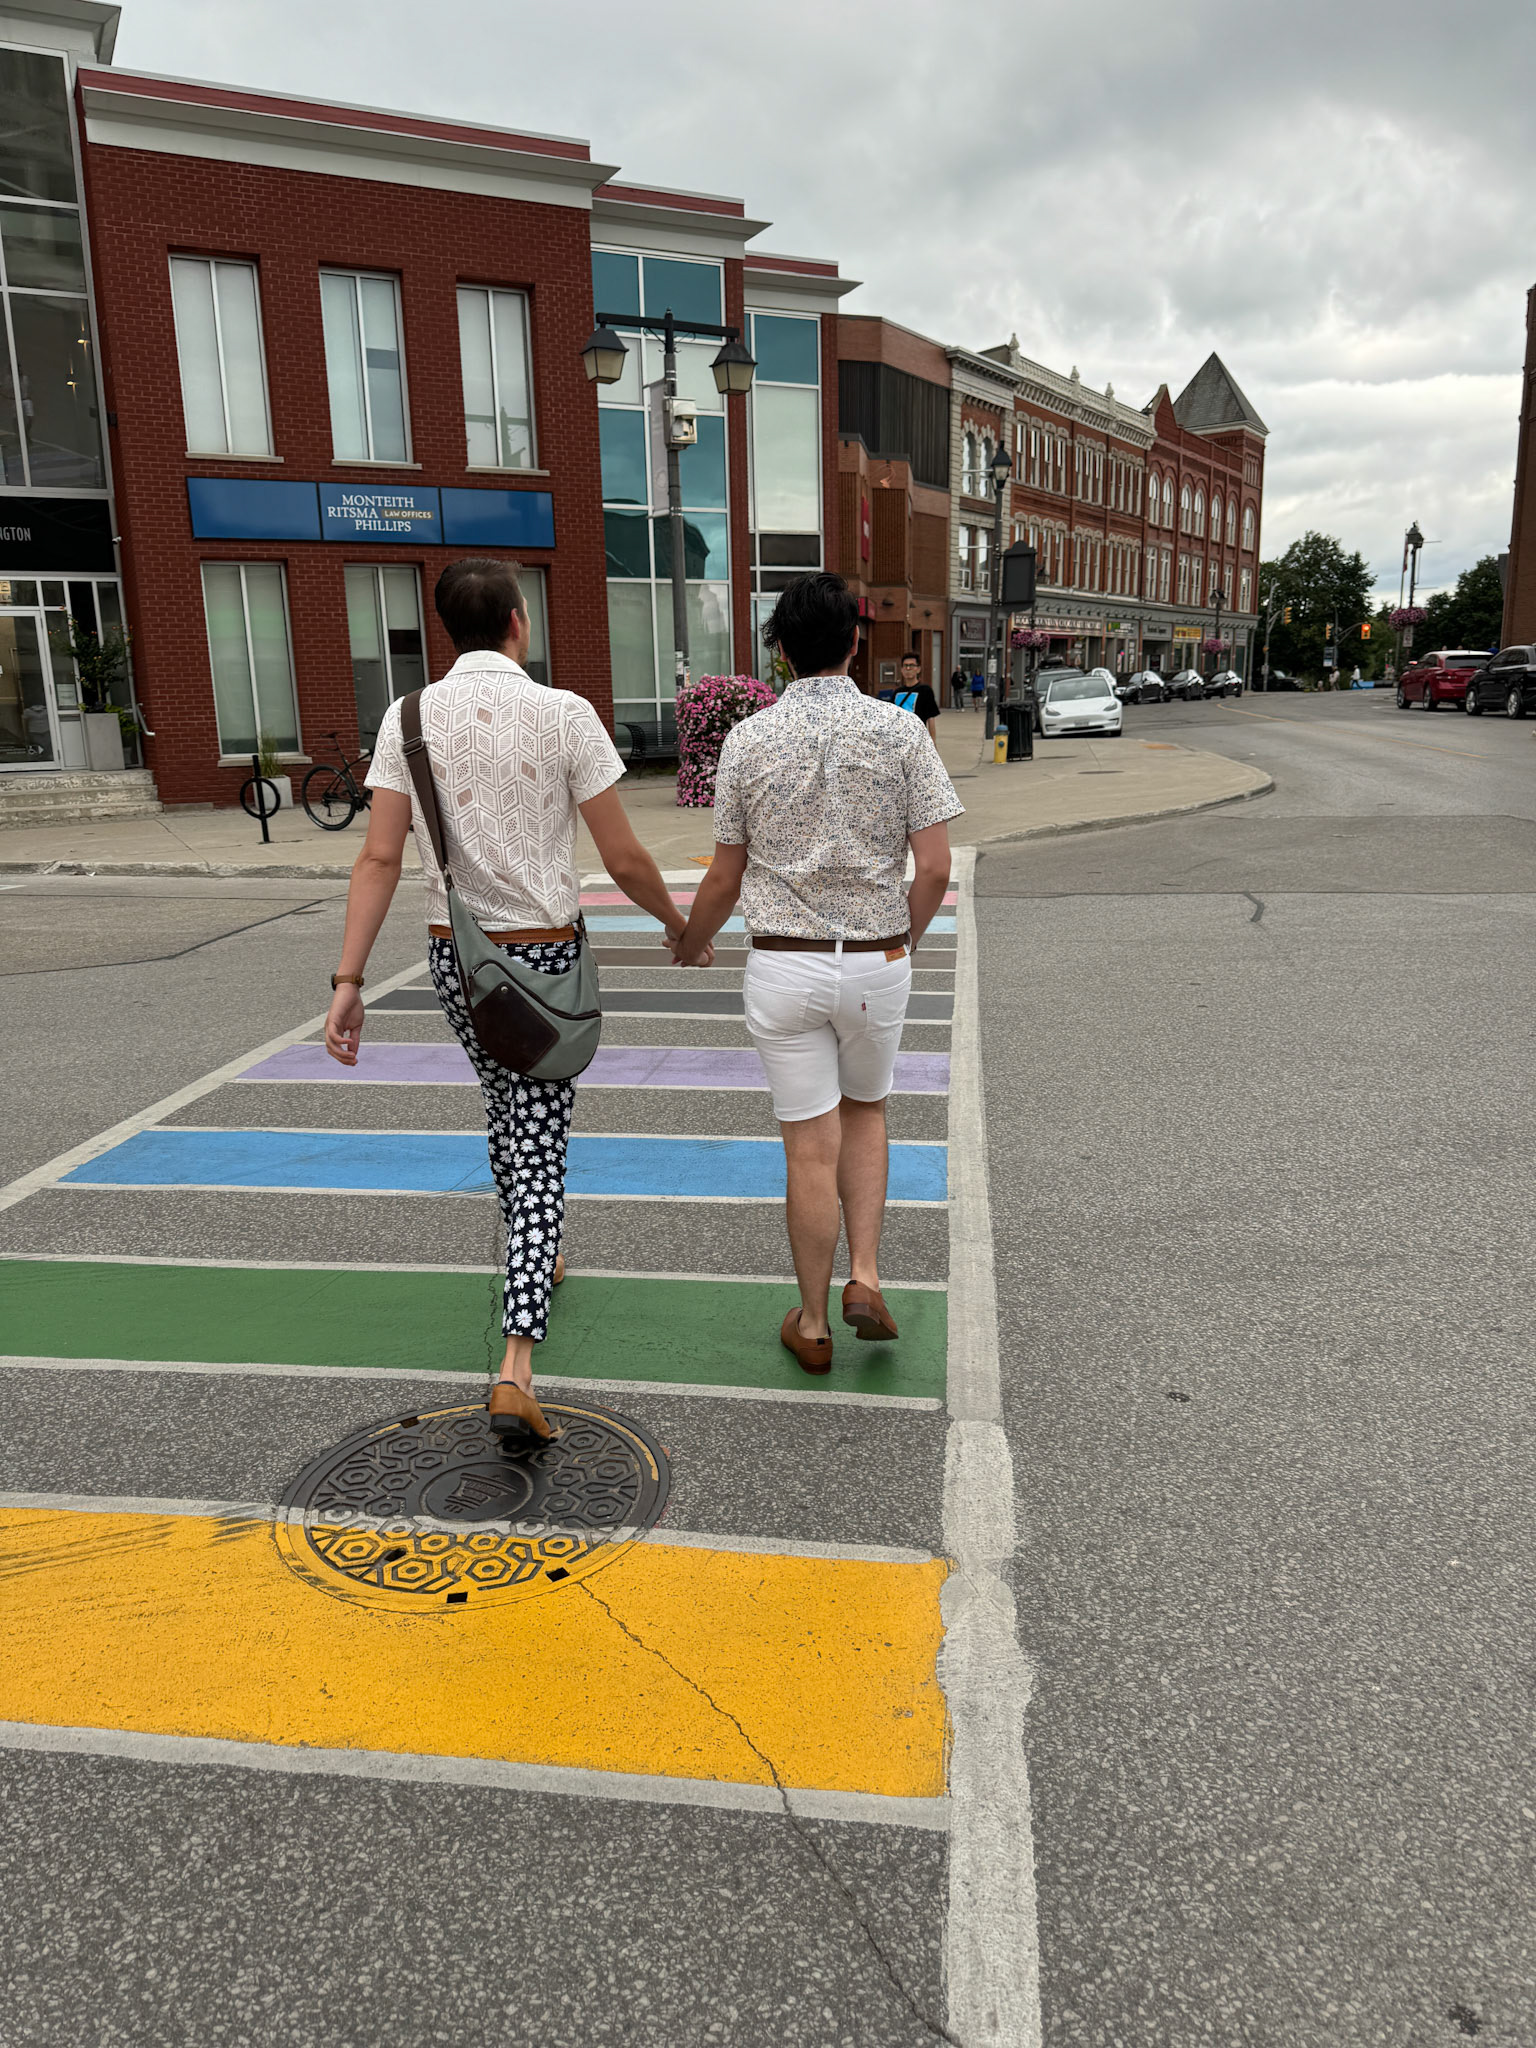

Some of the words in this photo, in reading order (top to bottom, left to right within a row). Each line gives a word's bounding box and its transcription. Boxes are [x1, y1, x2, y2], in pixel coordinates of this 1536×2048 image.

[342, 494, 414, 508] MONTEITH
[327, 506, 379, 519] RITSMA
[384, 510, 400, 518] LAW
[401, 510, 432, 519] OFFICES
[355, 519, 412, 532] PHILLIPS
